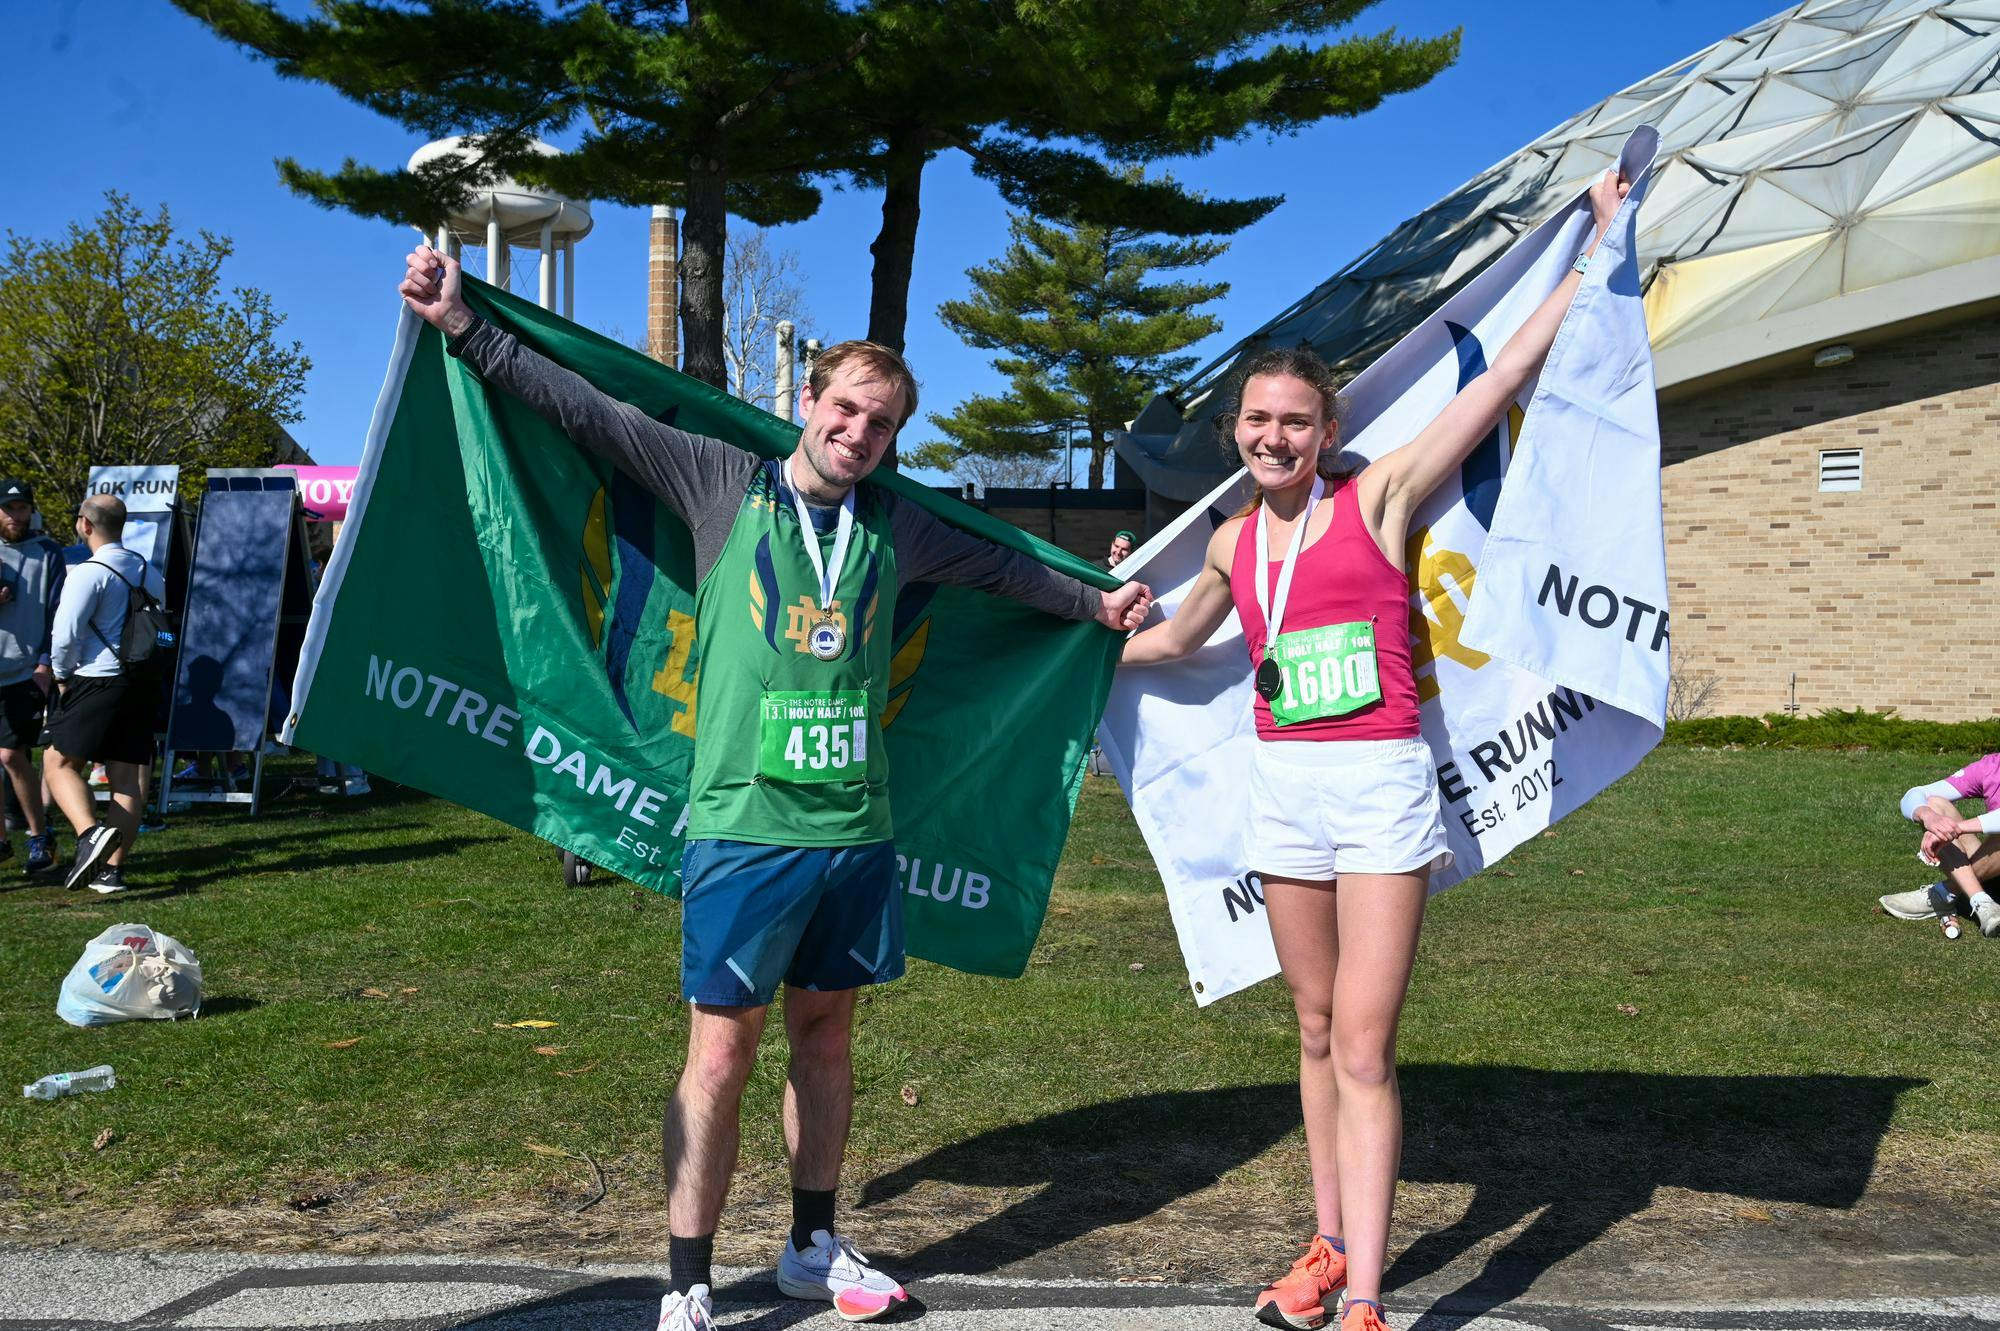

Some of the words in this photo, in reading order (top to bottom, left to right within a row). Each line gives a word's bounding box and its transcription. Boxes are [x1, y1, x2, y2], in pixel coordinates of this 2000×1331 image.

[88, 482, 126, 495] 10K
[132, 480, 175, 494] RUN
[1351, 635, 1371, 648] 10K
[789, 698, 802, 707] THE
[804, 698, 826, 707] NOTRE
[1281, 654, 1365, 710] 1600
[788, 707, 814, 719] HOLY
[817, 706, 841, 719] HALF
[848, 706, 865, 718] 10K
[365, 654, 522, 747] NOTRE
[523, 725, 668, 827] DAME
[784, 725, 849, 769] 435
[1459, 799, 1506, 838] Est.
[1511, 758, 1564, 811] 2012
[615, 826, 663, 867] Est.
